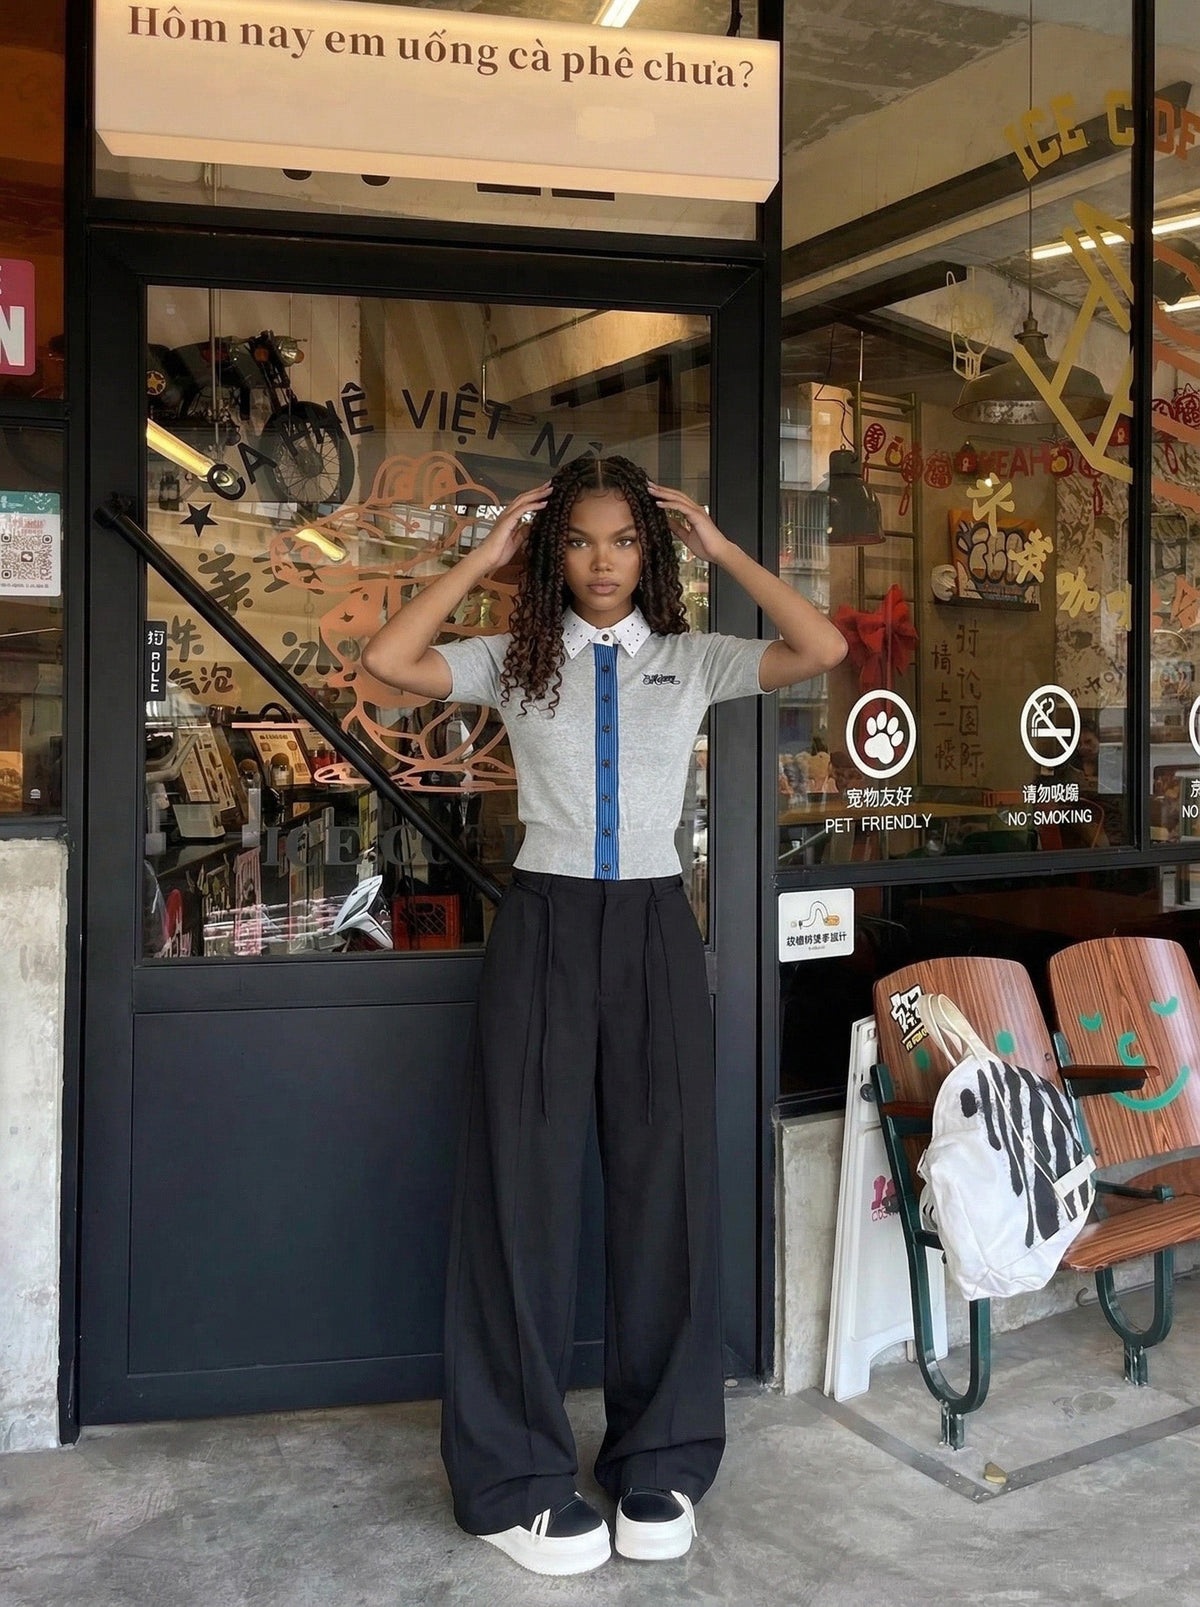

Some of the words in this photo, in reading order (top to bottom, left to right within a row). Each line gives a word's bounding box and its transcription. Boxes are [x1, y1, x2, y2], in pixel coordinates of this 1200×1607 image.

[128, 5, 228, 43] Hôm
[240, 23, 315, 59] nay
[325, 29, 386, 57] em
[397, 29, 499, 76] uống
[508, 38, 552, 72] cà
[561, 46, 634, 82] phê
[643, 52, 754, 88] chưa?
[1004, 92, 1088, 182] ICE
[402, 382, 511, 445] VIỆT
[825, 817, 853, 834] PET
[861, 813, 932, 832] FRIENDLY
[1008, 811, 1027, 826] NO
[1033, 808, 1093, 826] SMOKING
[1182, 804, 1199, 818] NO
